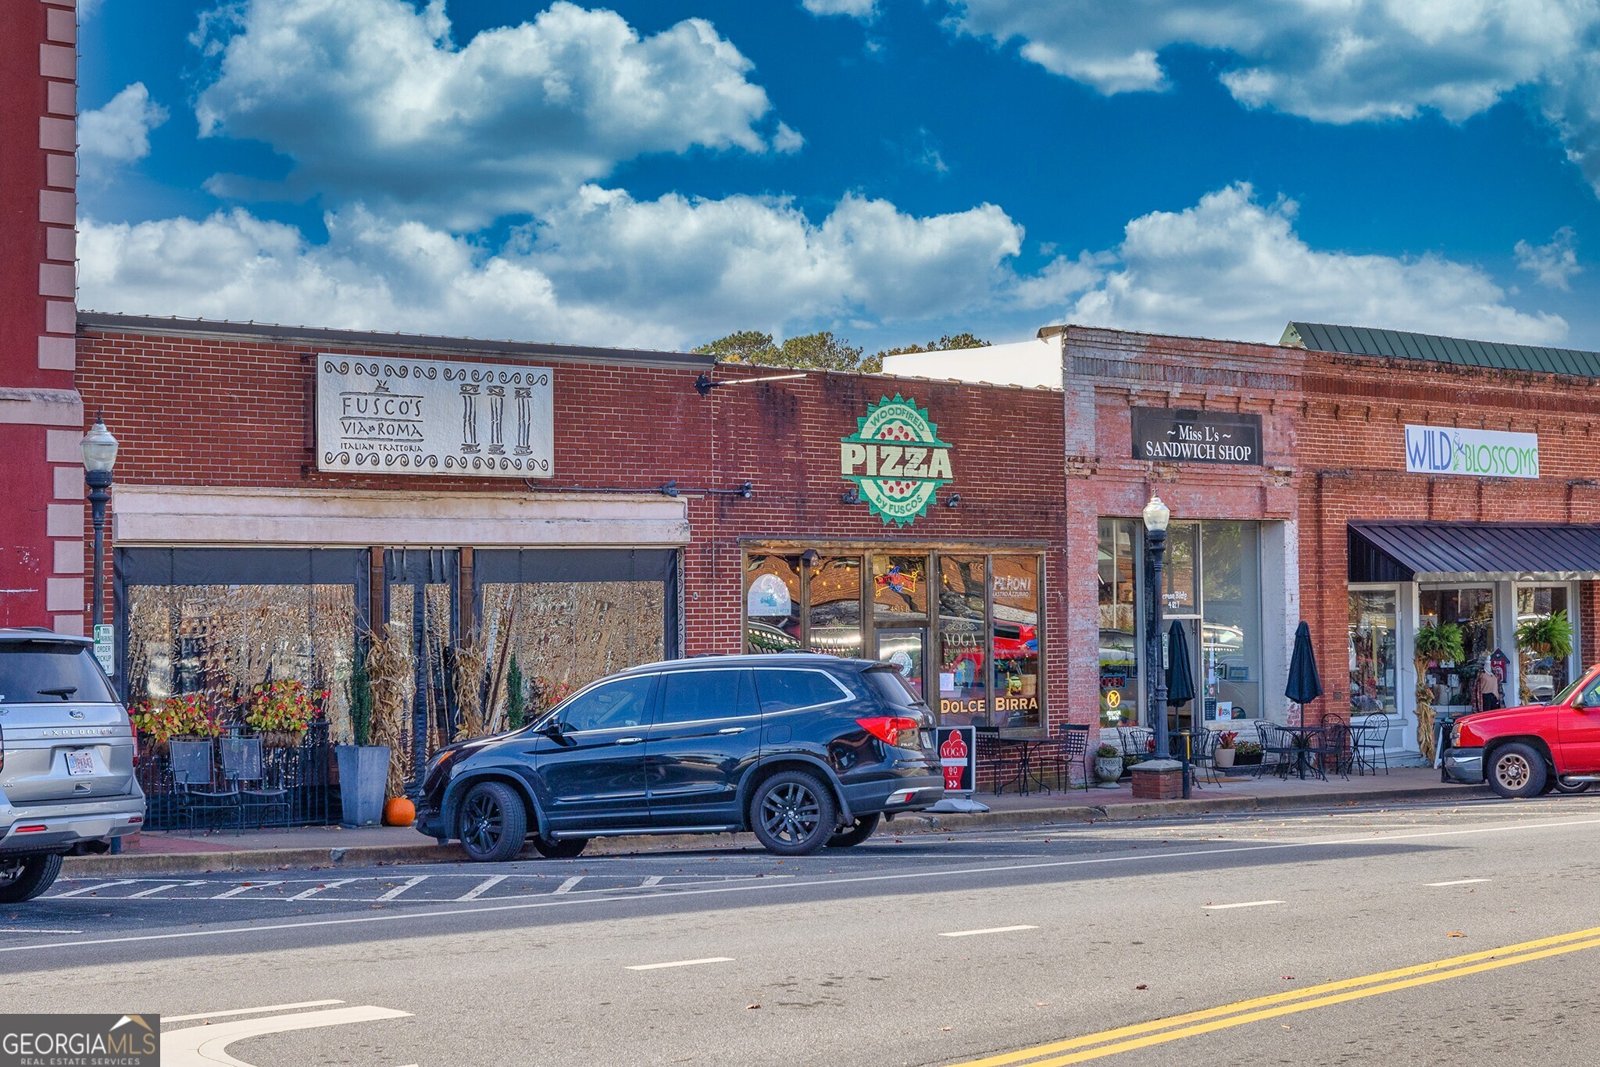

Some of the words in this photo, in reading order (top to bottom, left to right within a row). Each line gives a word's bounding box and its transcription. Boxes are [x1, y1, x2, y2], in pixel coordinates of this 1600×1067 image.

[342, 397, 422, 417] FUSCO'S
[870, 406, 925, 432] WOODFIRED
[341, 421, 370, 435] VIA
[377, 422, 423, 438] ROMA
[1178, 424, 1203, 441] Miss
[1204, 426, 1220, 442] L's
[340, 442, 375, 451] ITALIAN
[378, 444, 423, 453] TRATTORIA
[1145, 440, 1217, 460] SANDWICH
[1218, 444, 1252, 461] SHOP
[1406, 428, 1452, 471] WILD
[1464, 443, 1538, 476] BLOSSOMS
[840, 442, 954, 479] PIZZA
[993, 576, 1032, 591] PERONI
[940, 699, 986, 714] DOLCE
[995, 697, 1038, 711] BIRRA
